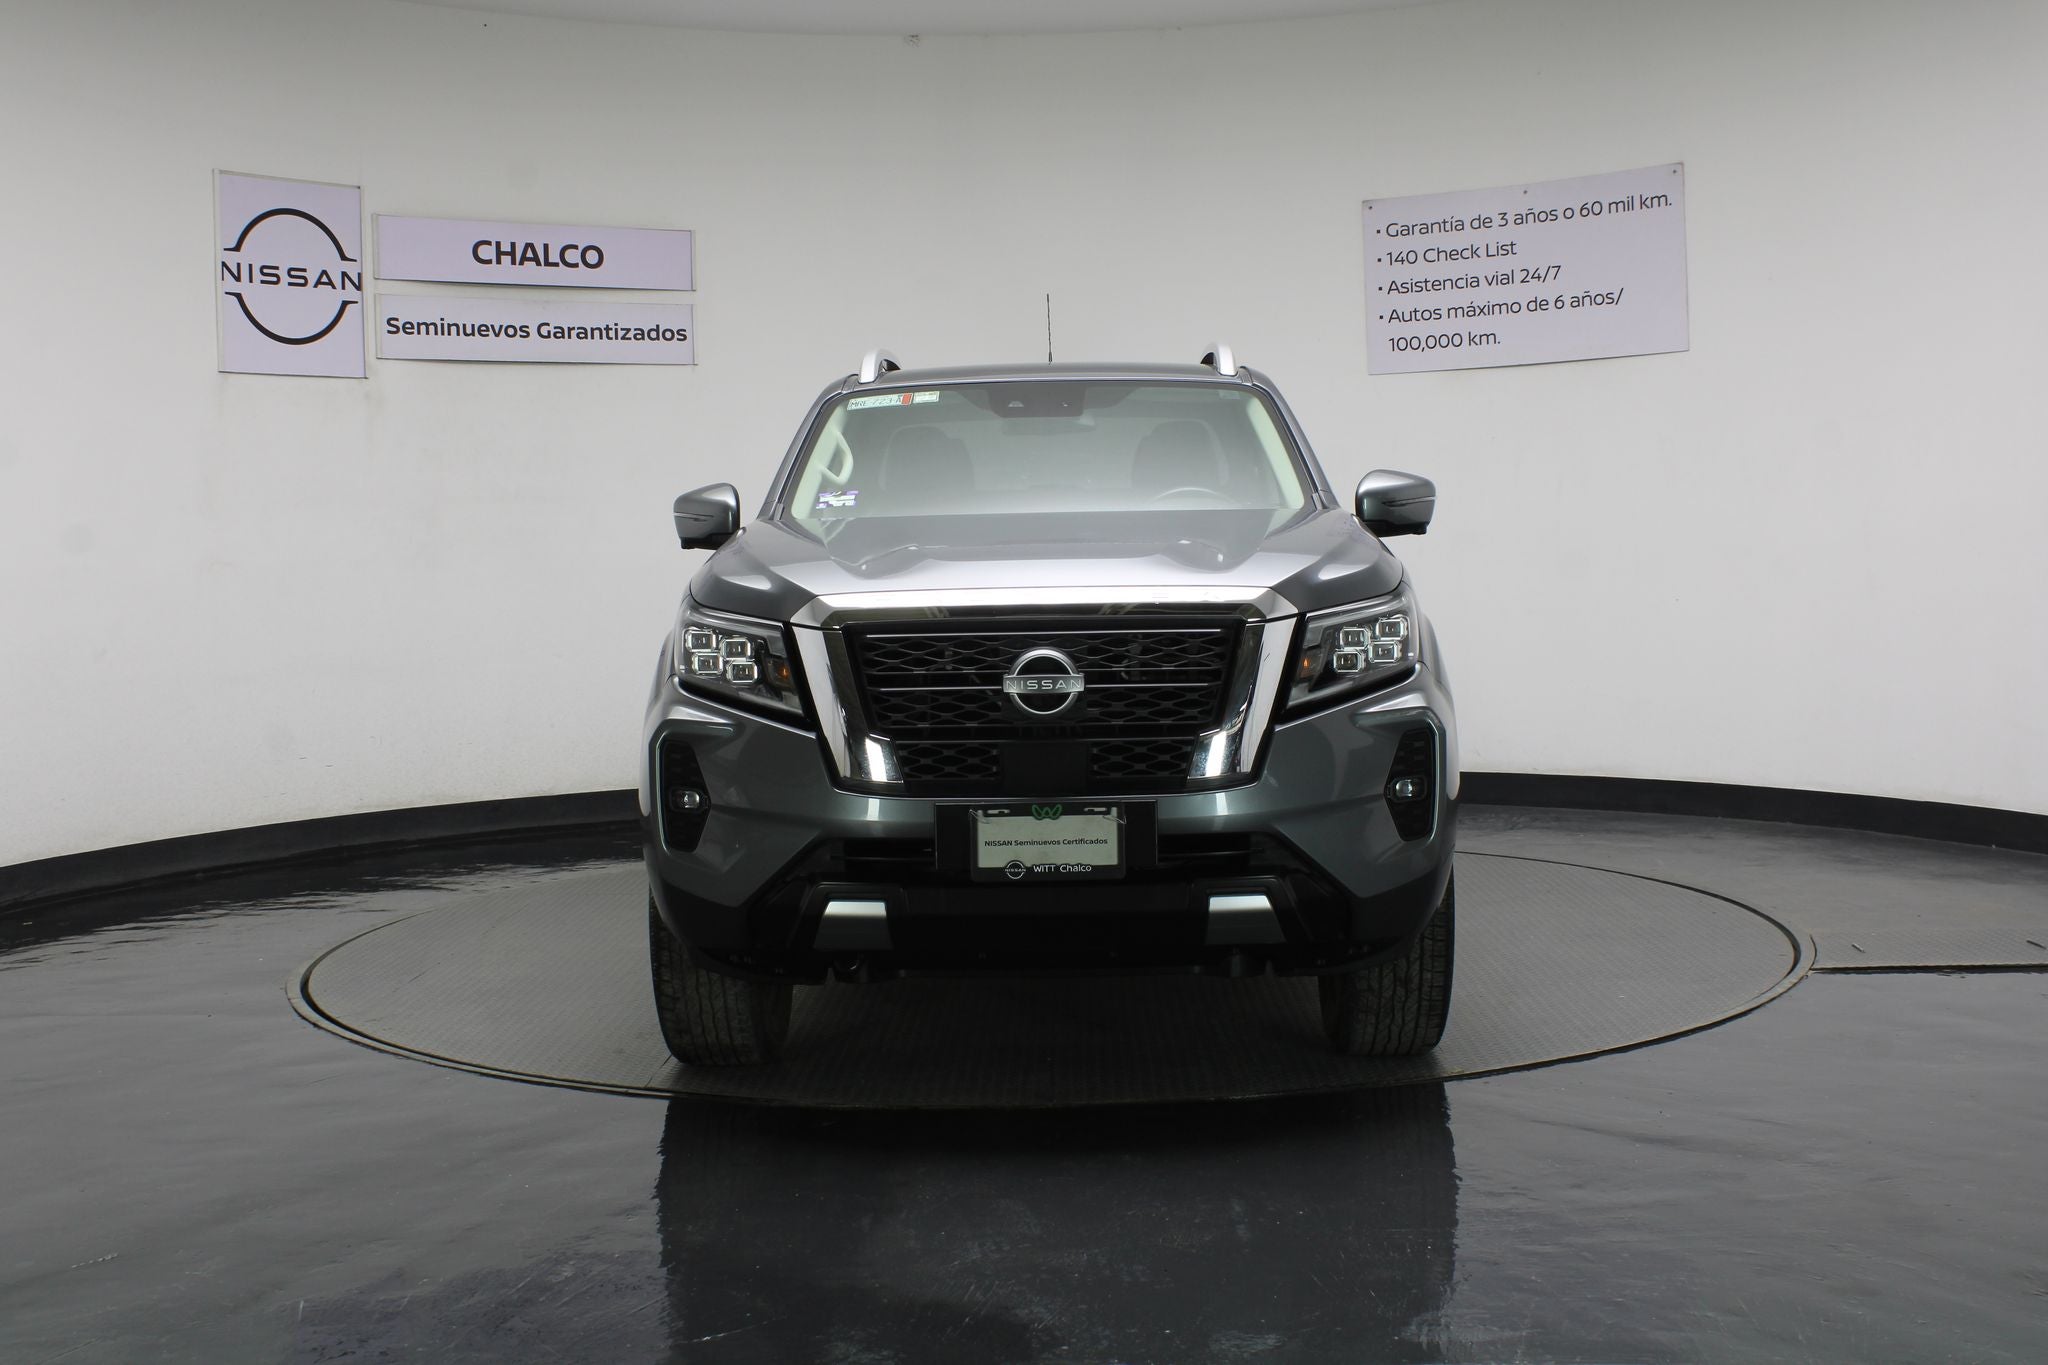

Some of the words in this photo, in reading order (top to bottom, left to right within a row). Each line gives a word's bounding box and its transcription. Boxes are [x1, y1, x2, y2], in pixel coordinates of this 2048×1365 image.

[1386, 216, 1465, 238] Garantía
[1469, 212, 1493, 230] de
[1497, 212, 1509, 227] 3
[1513, 204, 1558, 225] años
[1562, 206, 1574, 220] o
[1579, 200, 1603, 218] 60
[1607, 195, 1635, 214] mil
[1639, 192, 1672, 210] km.
[471, 239, 605, 269] CHALCO
[1386, 250, 1418, 266] 140
[1423, 244, 1481, 264] Check
[1486, 240, 1517, 257] List
[221, 260, 362, 292] NISSAN
[1387, 274, 1480, 295] Asistencia
[1484, 269, 1515, 288] vial
[1520, 265, 1562, 284] 24/7
[1388, 305, 1442, 324] Autos
[1447, 300, 1522, 320] máximo
[1526, 296, 1549, 313] de
[1554, 294, 1565, 310] 6
[1570, 287, 1625, 308] años/
[386, 316, 531, 339] Seminuevos
[536, 320, 688, 342] Garantizados
[1388, 332, 1463, 353] 100,000
[1468, 330, 1501, 347] km.
[1006, 679, 1081, 690] NISSAN
[984, 839, 1013, 847] NISSAN
[1014, 838, 1061, 847] Seminuevos
[1062, 837, 1108, 846] Certificados
[1033, 864, 1056, 873] WITT
[1059, 864, 1092, 873] Chalco
